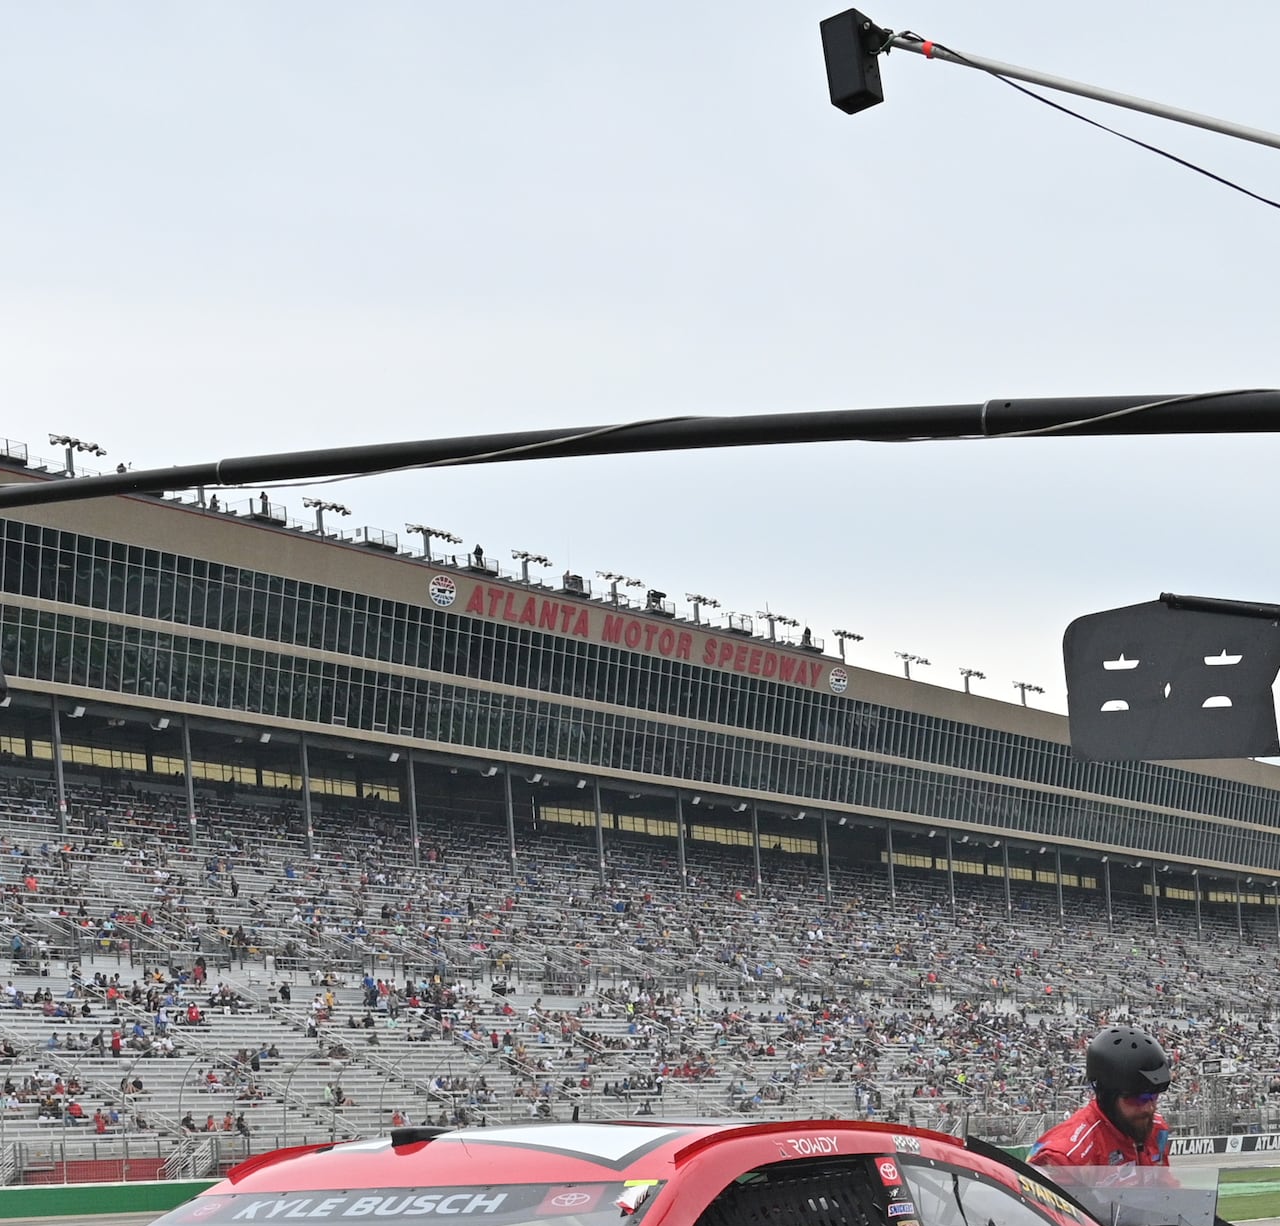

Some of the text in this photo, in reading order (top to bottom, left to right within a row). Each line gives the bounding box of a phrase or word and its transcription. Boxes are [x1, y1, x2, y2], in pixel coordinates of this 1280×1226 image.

[466, 584, 822, 688] ATLANTA MOTOR SPEEDWAY
[787, 1136, 839, 1153] ROWDY
[1170, 1139, 1214, 1156] ATLANTA
[232, 1193, 509, 1220] KYLE BUSCH
